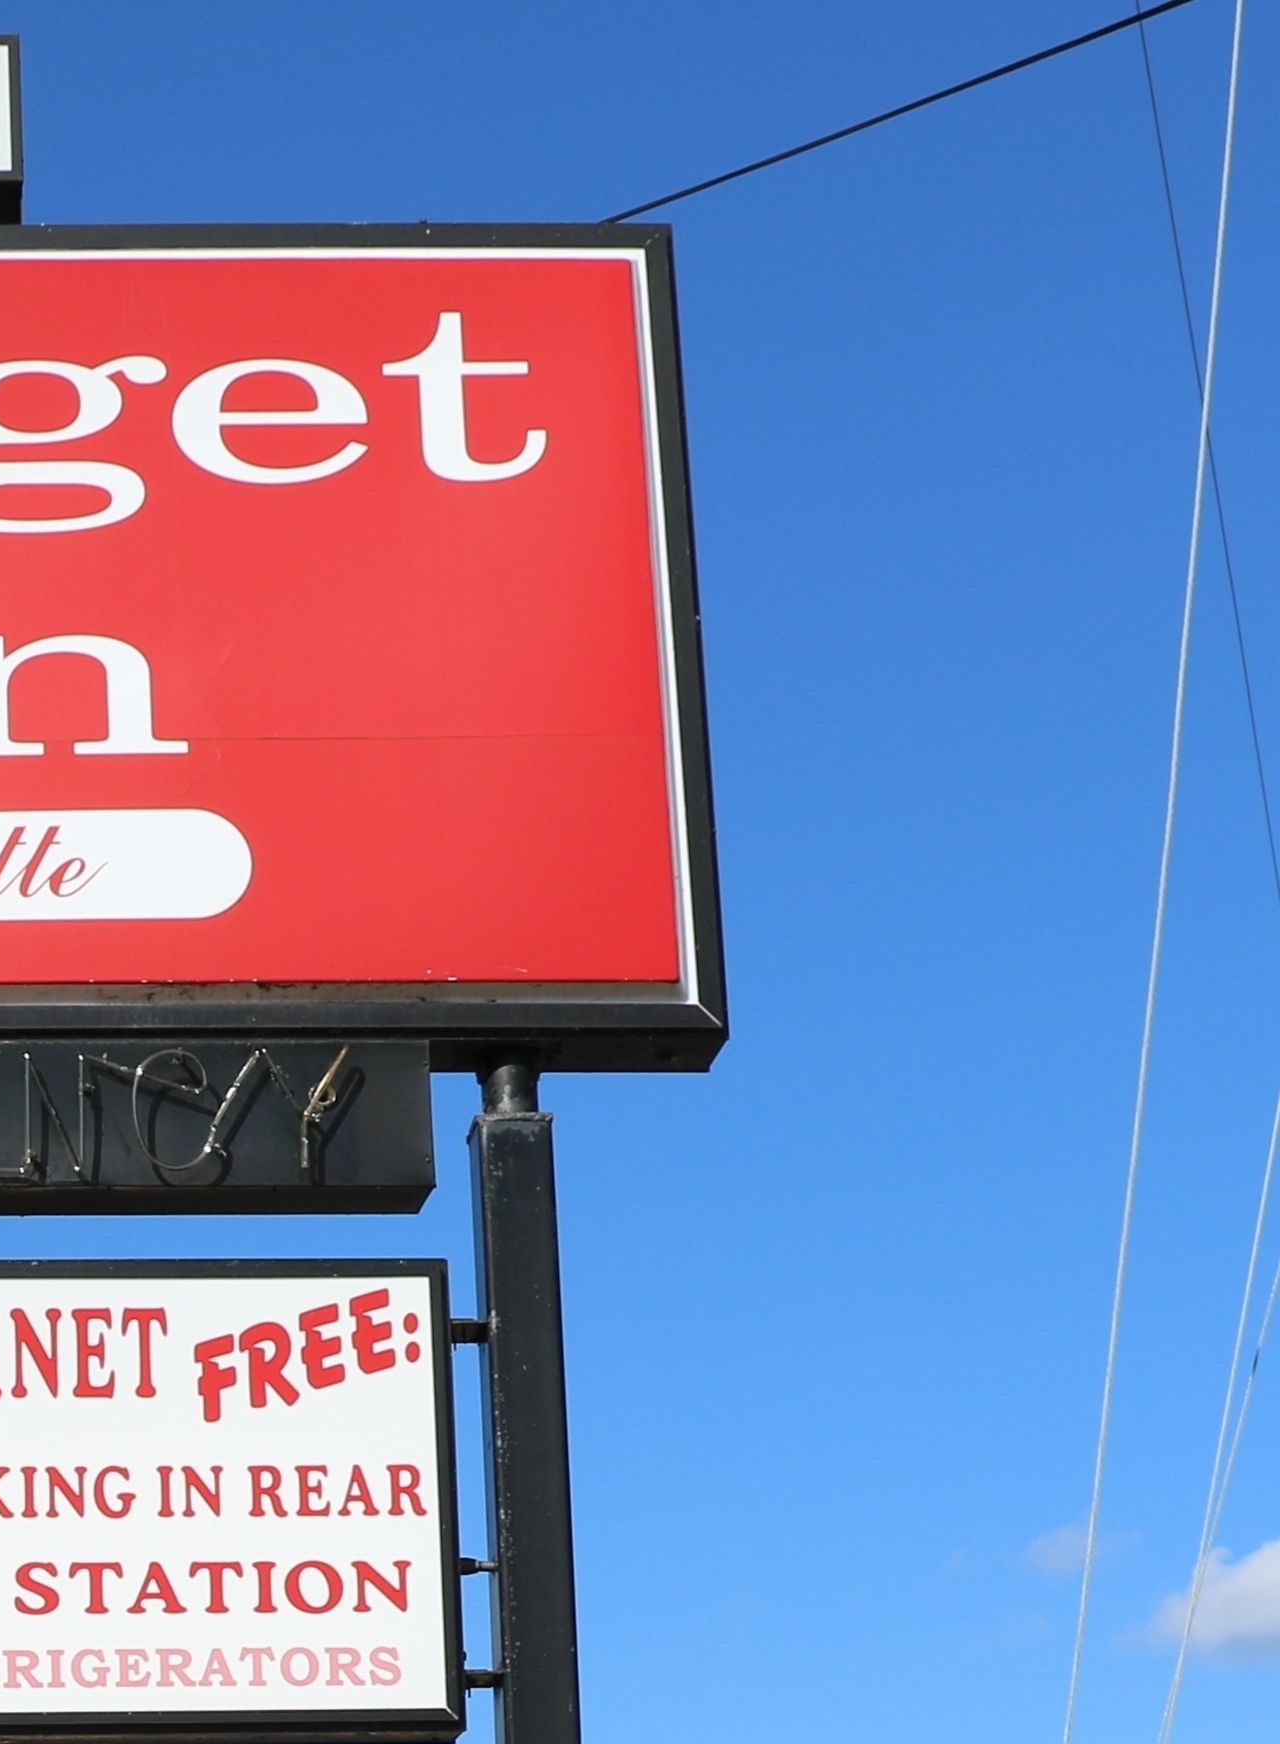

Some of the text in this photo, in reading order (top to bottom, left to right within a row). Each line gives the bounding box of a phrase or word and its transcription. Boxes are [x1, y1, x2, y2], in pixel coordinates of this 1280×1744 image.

[157, 1465, 223, 1518] IN
[248, 1464, 427, 1518] REAR
[15, 1560, 412, 1615] STATION
